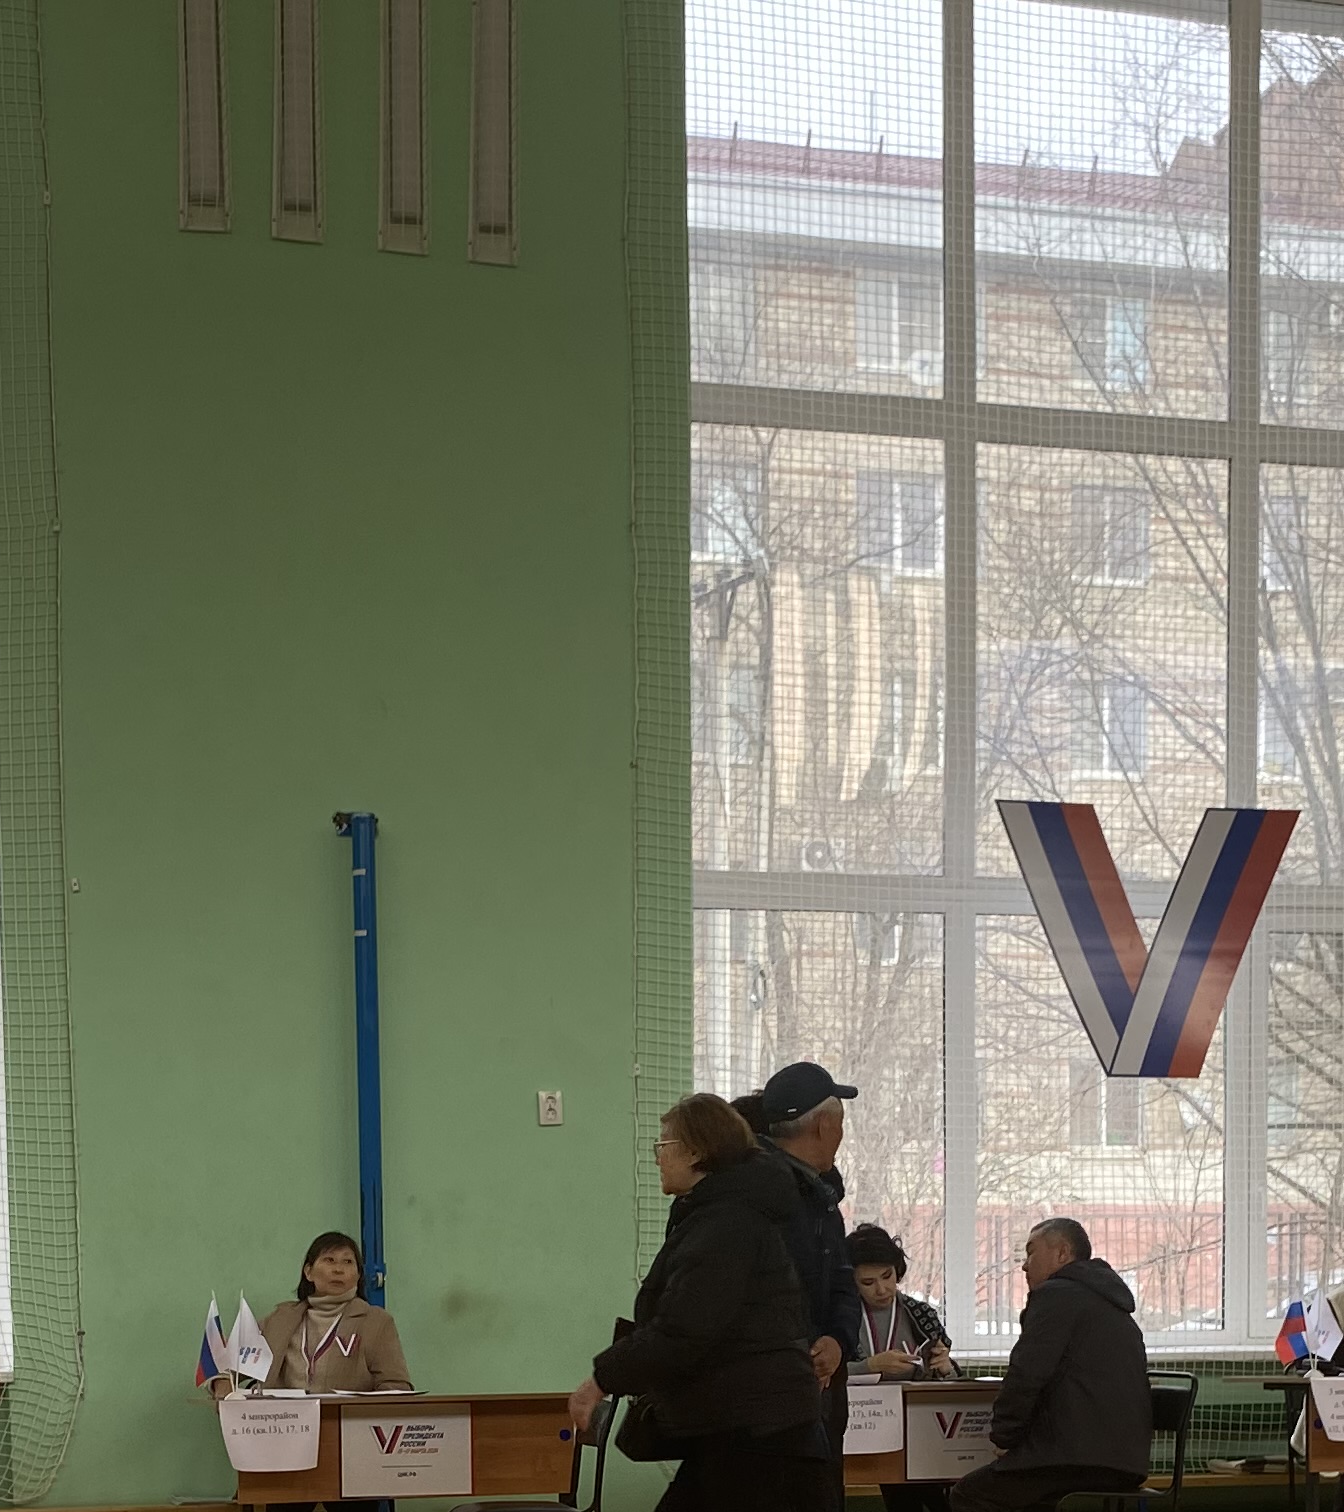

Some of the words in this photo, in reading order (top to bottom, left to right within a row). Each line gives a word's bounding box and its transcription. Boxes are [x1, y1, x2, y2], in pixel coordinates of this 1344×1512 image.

[994, 799, 1302, 1078] V
[241, 1412, 247, 1420] 4
[248, 1411, 299, 1422] микрорайон
[300, 1423, 310, 1433] 18
